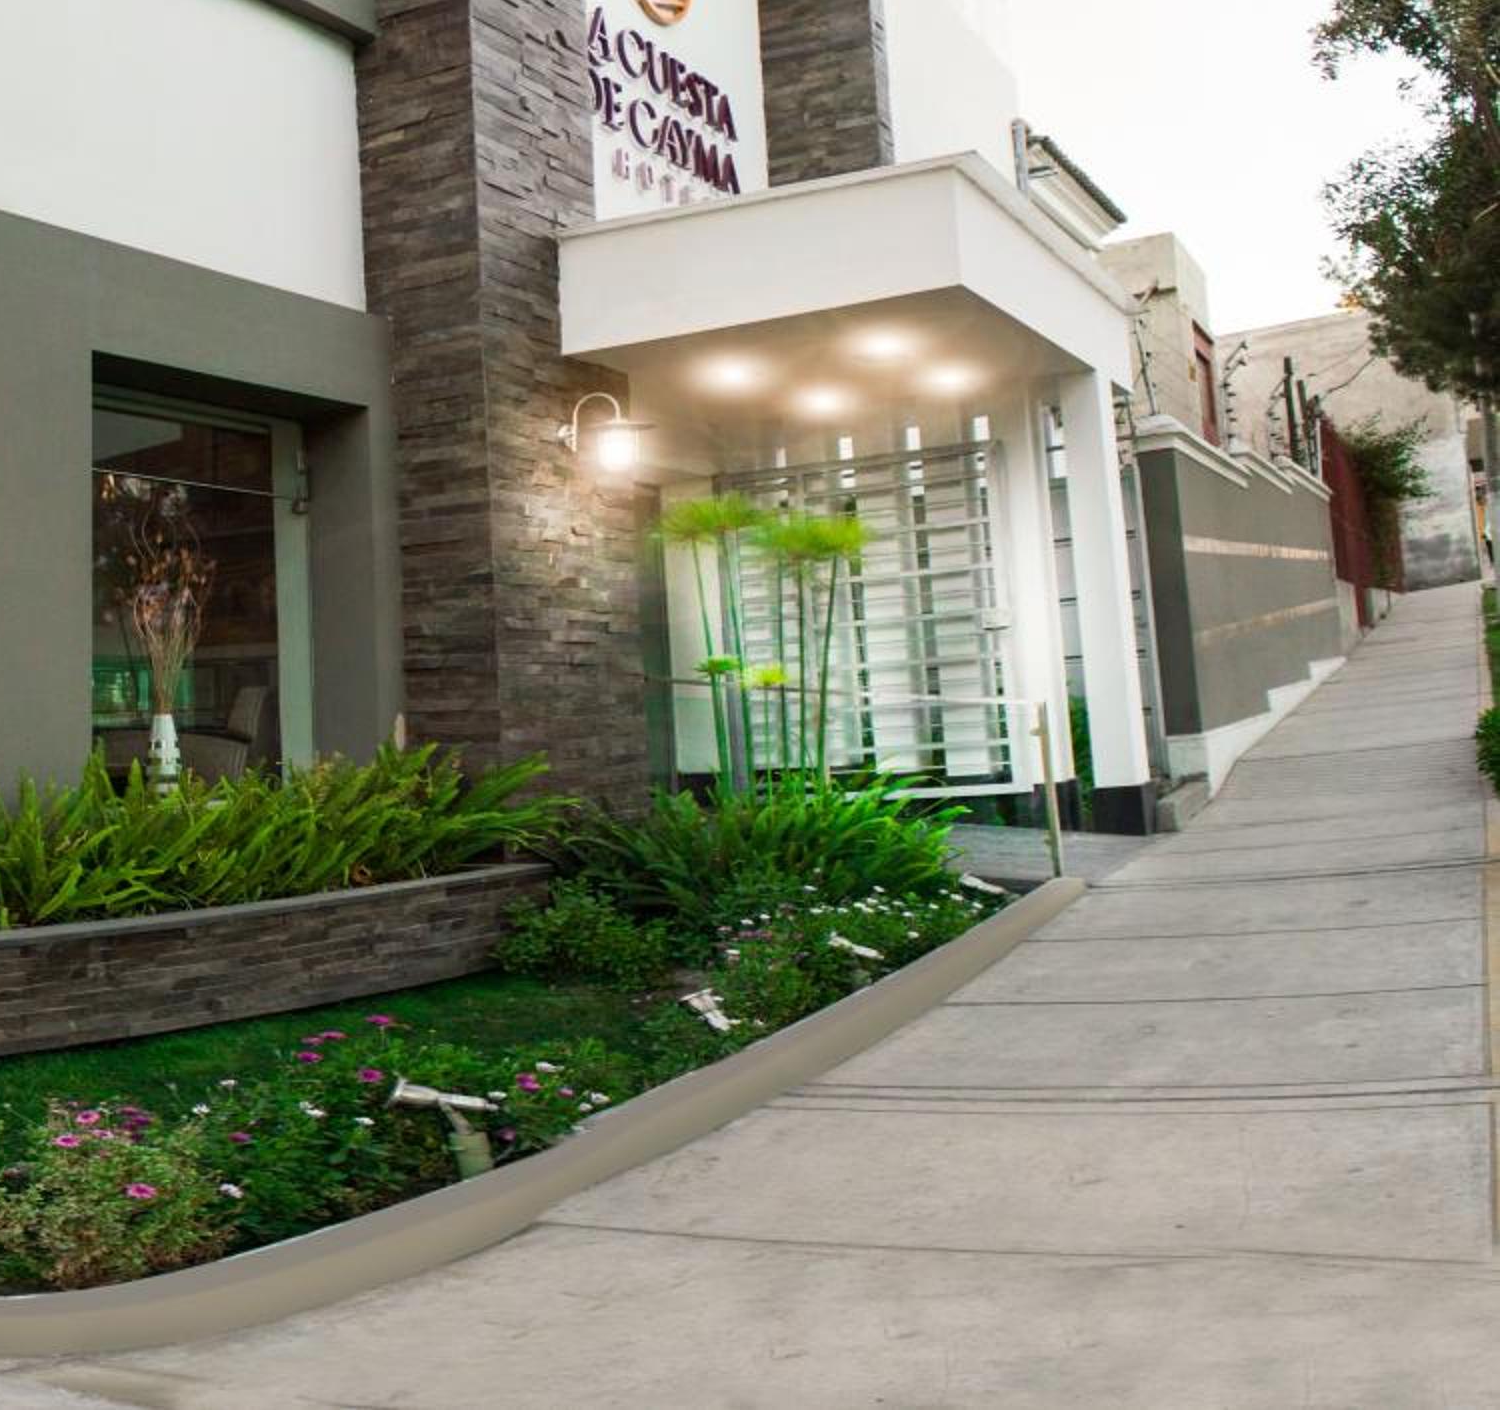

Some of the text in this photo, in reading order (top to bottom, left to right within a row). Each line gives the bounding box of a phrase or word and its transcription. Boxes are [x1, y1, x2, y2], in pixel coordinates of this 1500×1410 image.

[588, 6, 738, 141] A CUESTA
[629, 100, 740, 194] CAYMA
